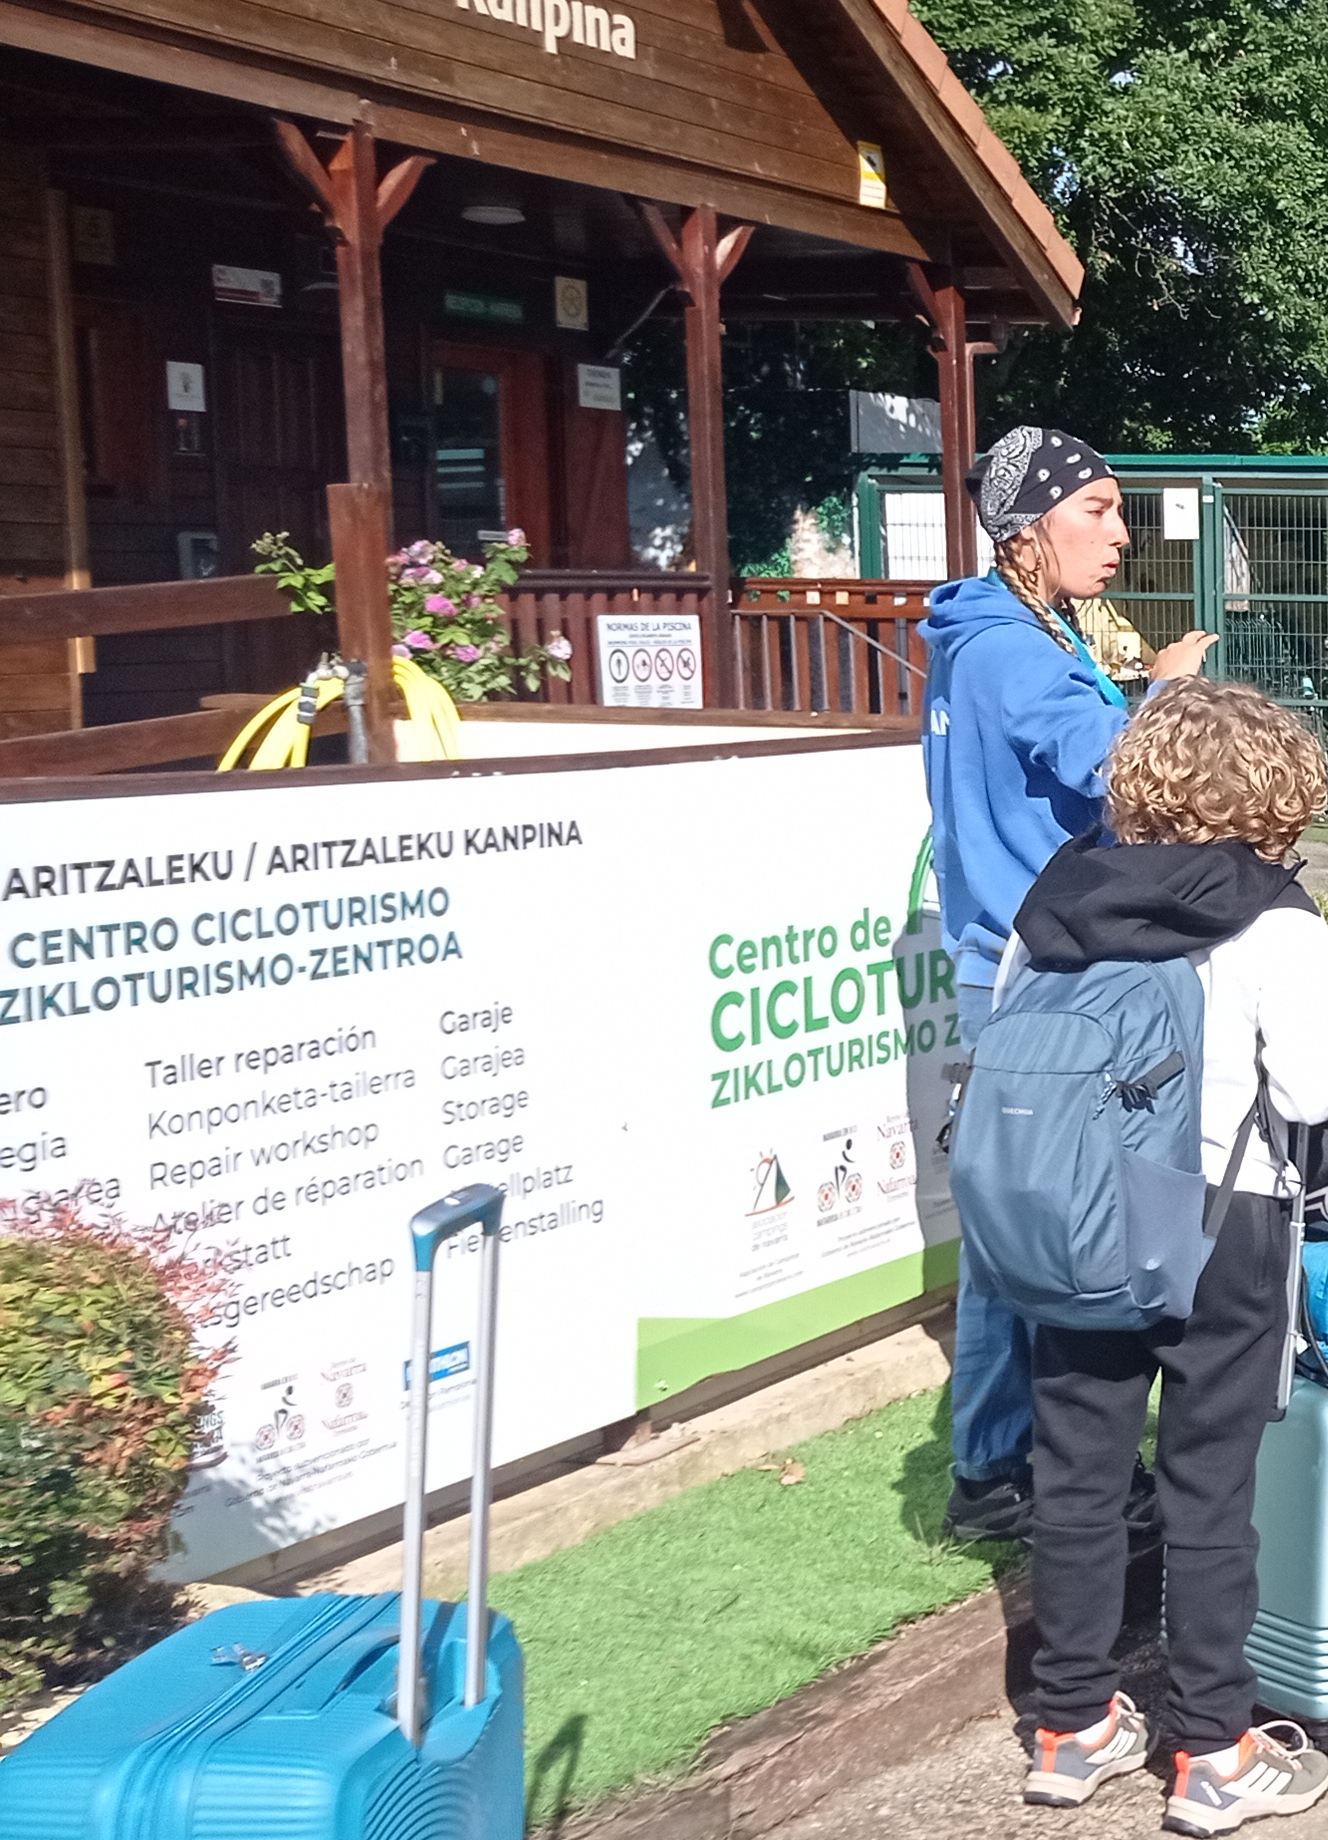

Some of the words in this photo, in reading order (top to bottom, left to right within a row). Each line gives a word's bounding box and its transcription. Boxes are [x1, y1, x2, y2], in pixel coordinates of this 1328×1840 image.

[2, 849, 233, 902] ARITZALEKU
[266, 830, 454, 876] ARITZALEKU
[464, 820, 583, 856] KANPINA
[8, 916, 179, 969] CENTRO
[191, 886, 450, 947] CICLOTURISMO
[708, 924, 838, 980] Centro
[850, 906, 892, 953] de
[0, 930, 463, 1026] ZIKLOTURISMO-ZENTROA
[439, 1000, 513, 1035] Garaje
[144, 1052, 226, 1088] Taller
[234, 1025, 376, 1074] reparación
[440, 1045, 525, 1080] Garajea
[711, 1019, 937, 1109] ZIKLOTURISMO
[148, 1068, 416, 1140] Konponketa-tailerra
[442, 1090, 529, 1125] Storage
[150, 1146, 243, 1190] Repair
[250, 1122, 380, 1167] workshop
[443, 1134, 524, 1169] Garage
[492, 1164, 574, 1200] ellplatz
[252, 1186, 287, 1216] de
[295, 1157, 424, 1207] réparation
